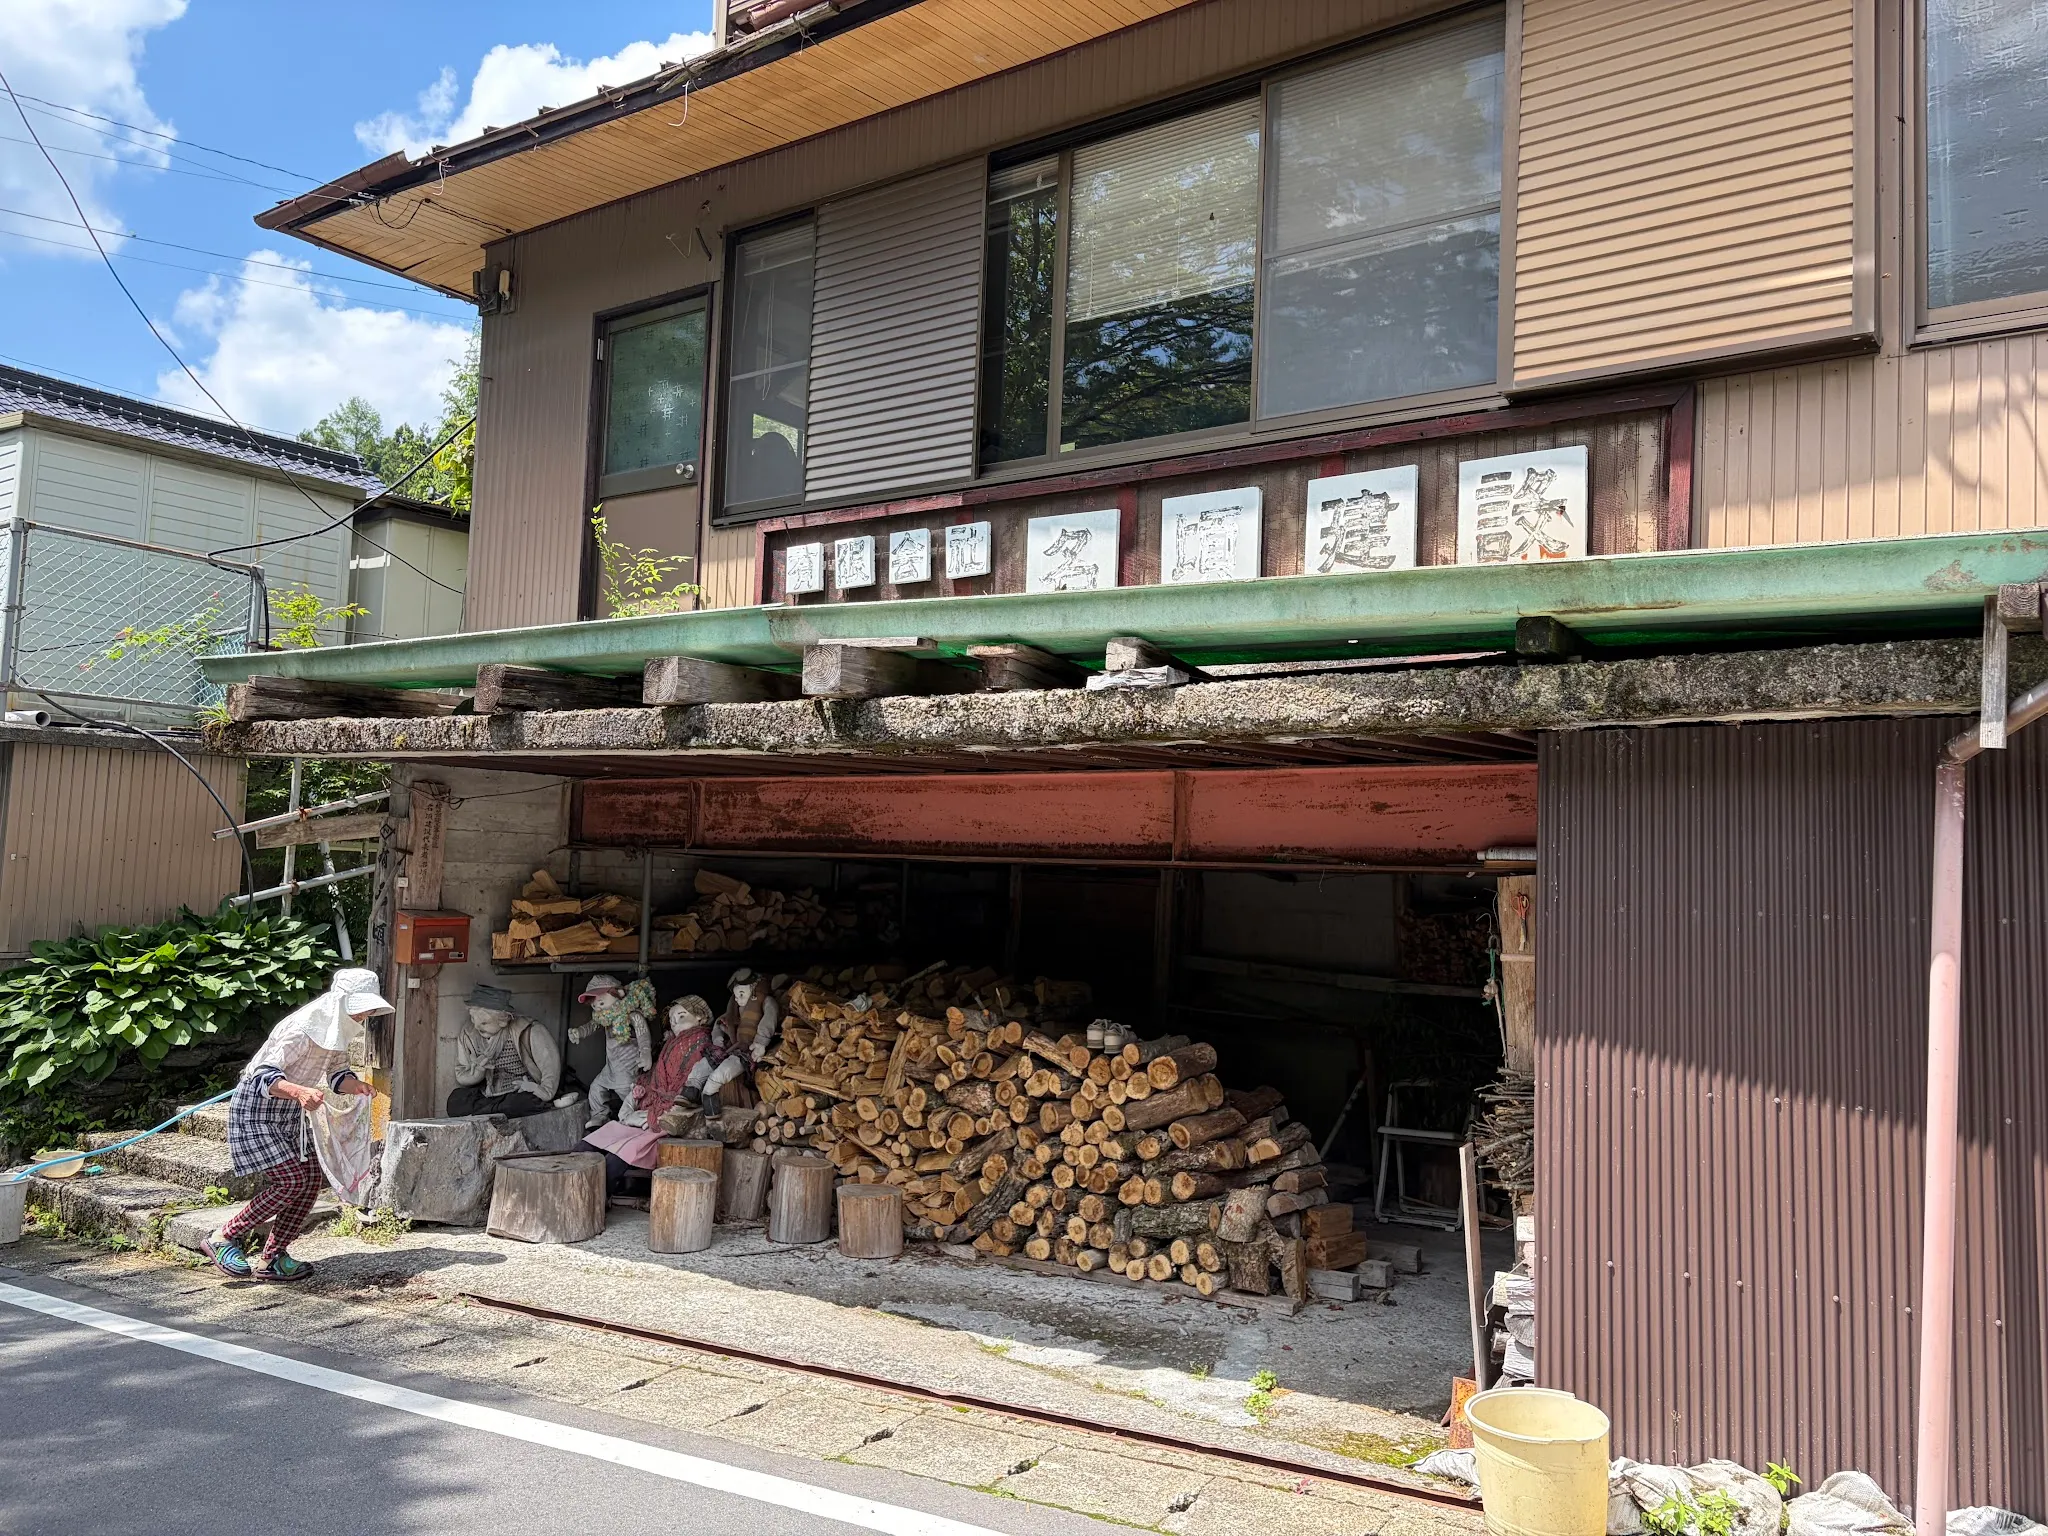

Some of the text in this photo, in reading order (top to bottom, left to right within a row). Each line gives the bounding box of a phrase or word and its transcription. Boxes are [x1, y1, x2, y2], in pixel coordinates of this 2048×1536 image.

[787, 466, 1571, 592] 有限会社 名頃建設
